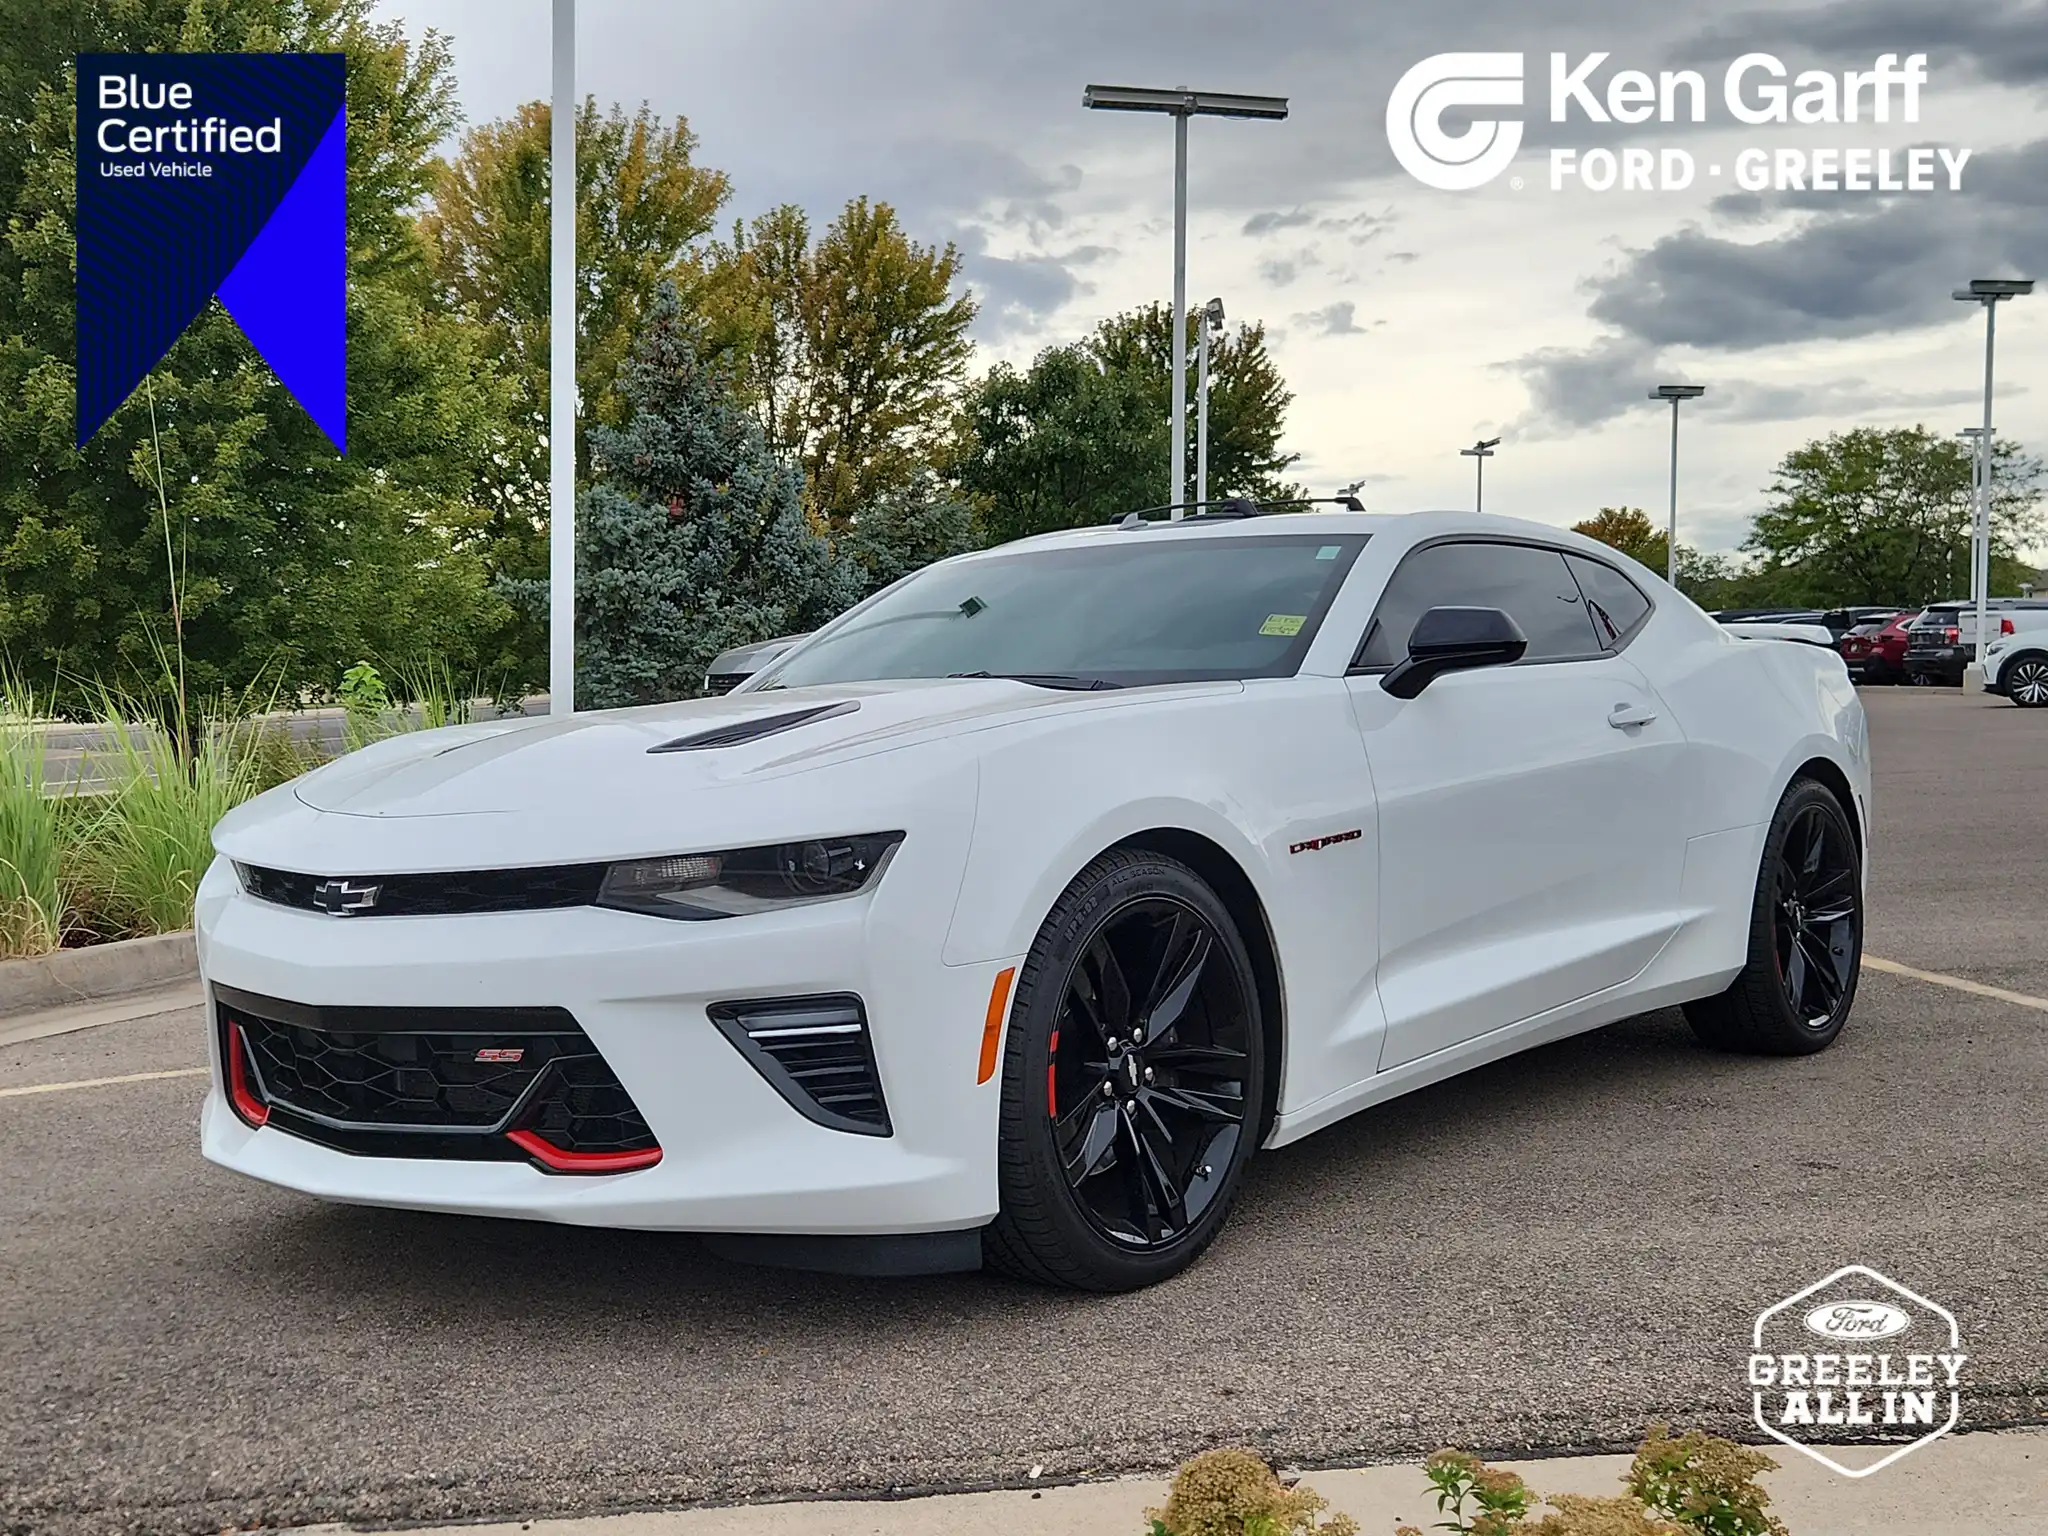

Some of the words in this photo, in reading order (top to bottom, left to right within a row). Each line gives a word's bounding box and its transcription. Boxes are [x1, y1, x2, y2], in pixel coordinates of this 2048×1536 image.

[1112, 875, 1129, 887] ALL
[1130, 867, 1165, 878] SEASON
[474, 1048, 524, 1062] SS
